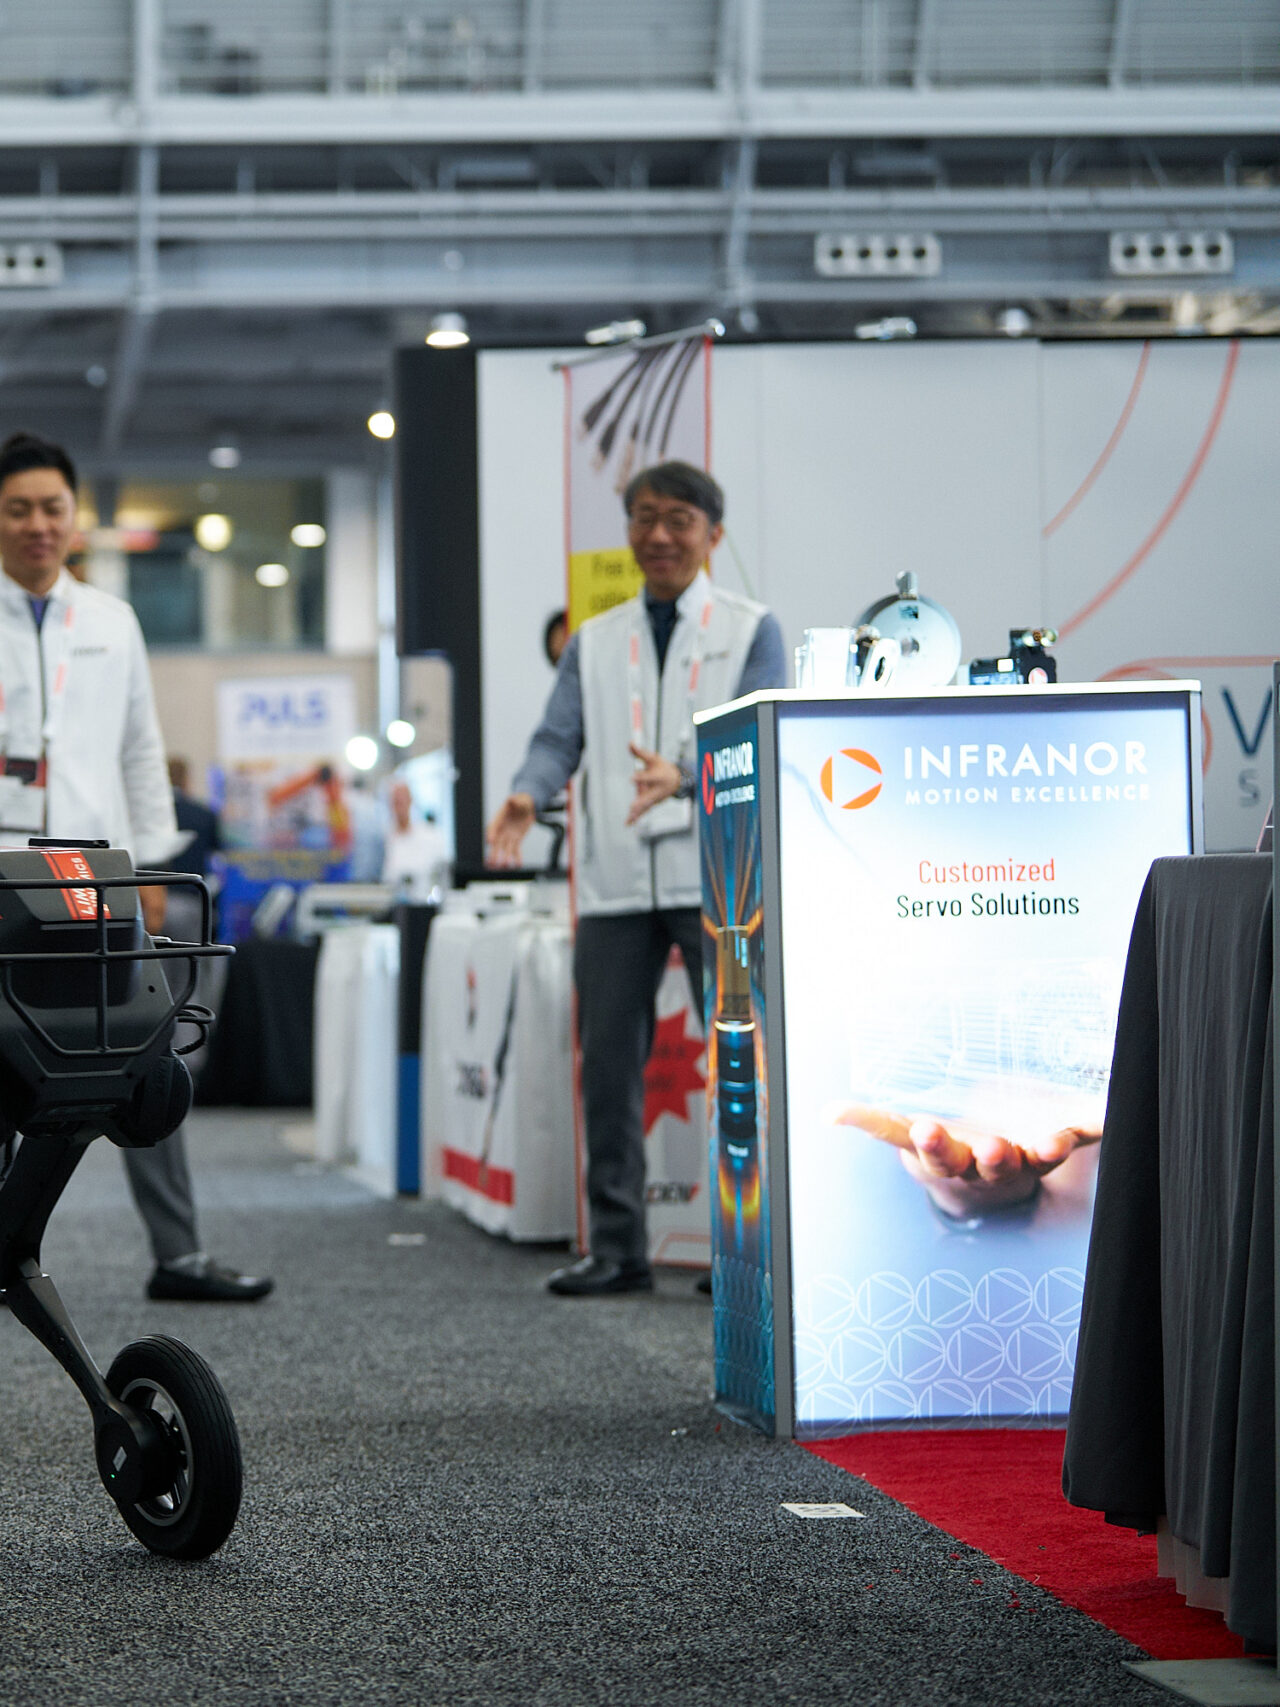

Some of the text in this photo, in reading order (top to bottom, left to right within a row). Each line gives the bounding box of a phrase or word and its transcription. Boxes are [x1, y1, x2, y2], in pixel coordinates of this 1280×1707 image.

[713, 742, 754, 783] INFRANOR
[904, 741, 1148, 780] INFRANOR
[905, 784, 1150, 806] MOTION EXCELLENCE
[919, 857, 1056, 884] Customized
[896, 891, 1080, 918] Servo Solutions
